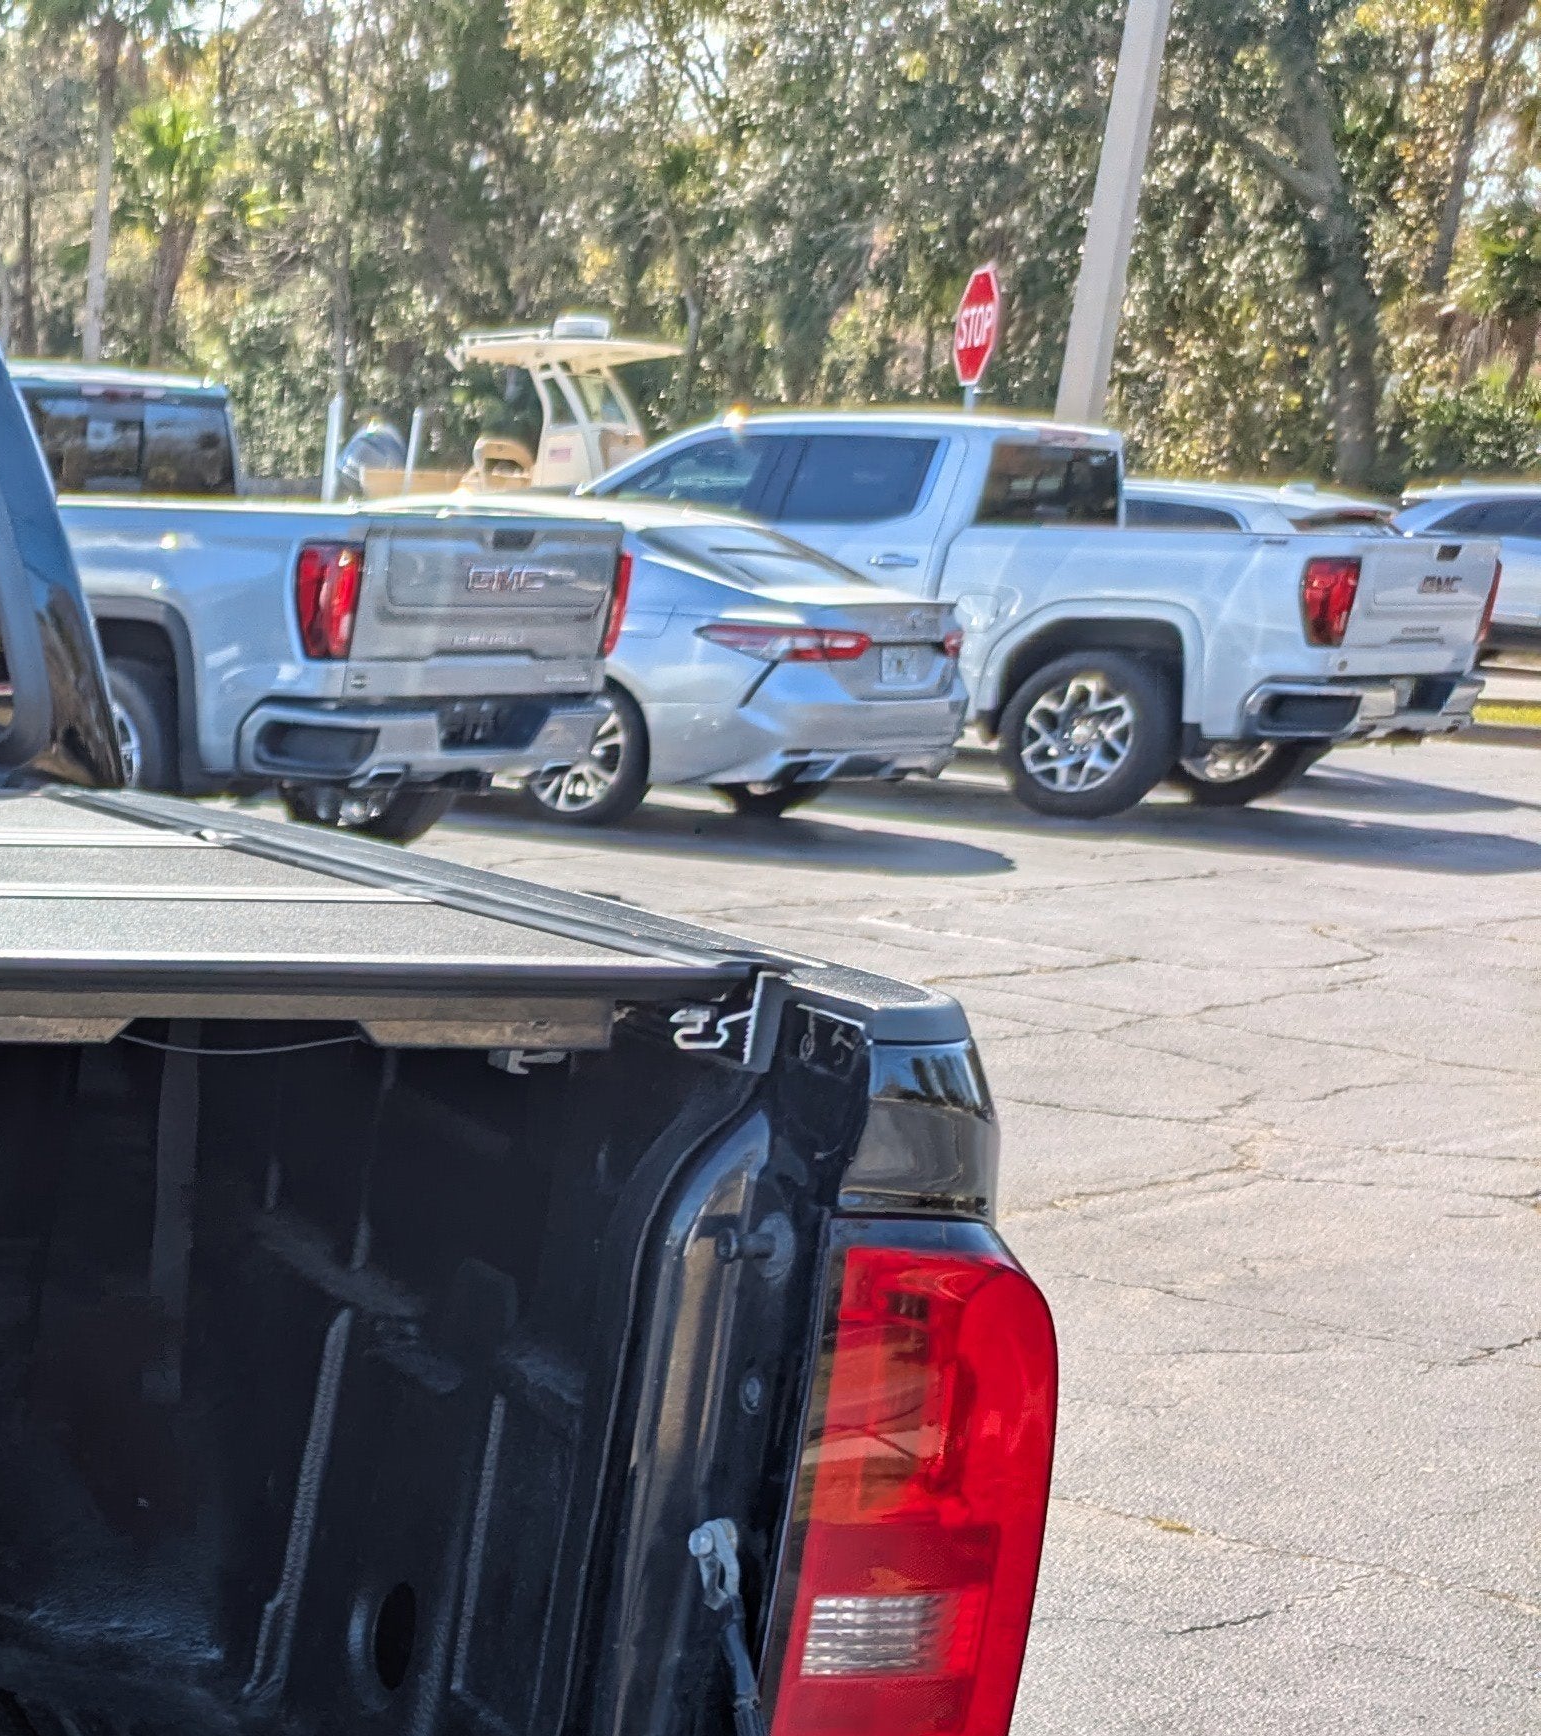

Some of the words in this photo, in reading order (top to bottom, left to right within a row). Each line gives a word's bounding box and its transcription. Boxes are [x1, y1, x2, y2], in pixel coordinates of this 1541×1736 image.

[958, 302, 993, 350] STOP
[467, 564, 549, 592] GMC
[1420, 575, 1462, 593] GMC
